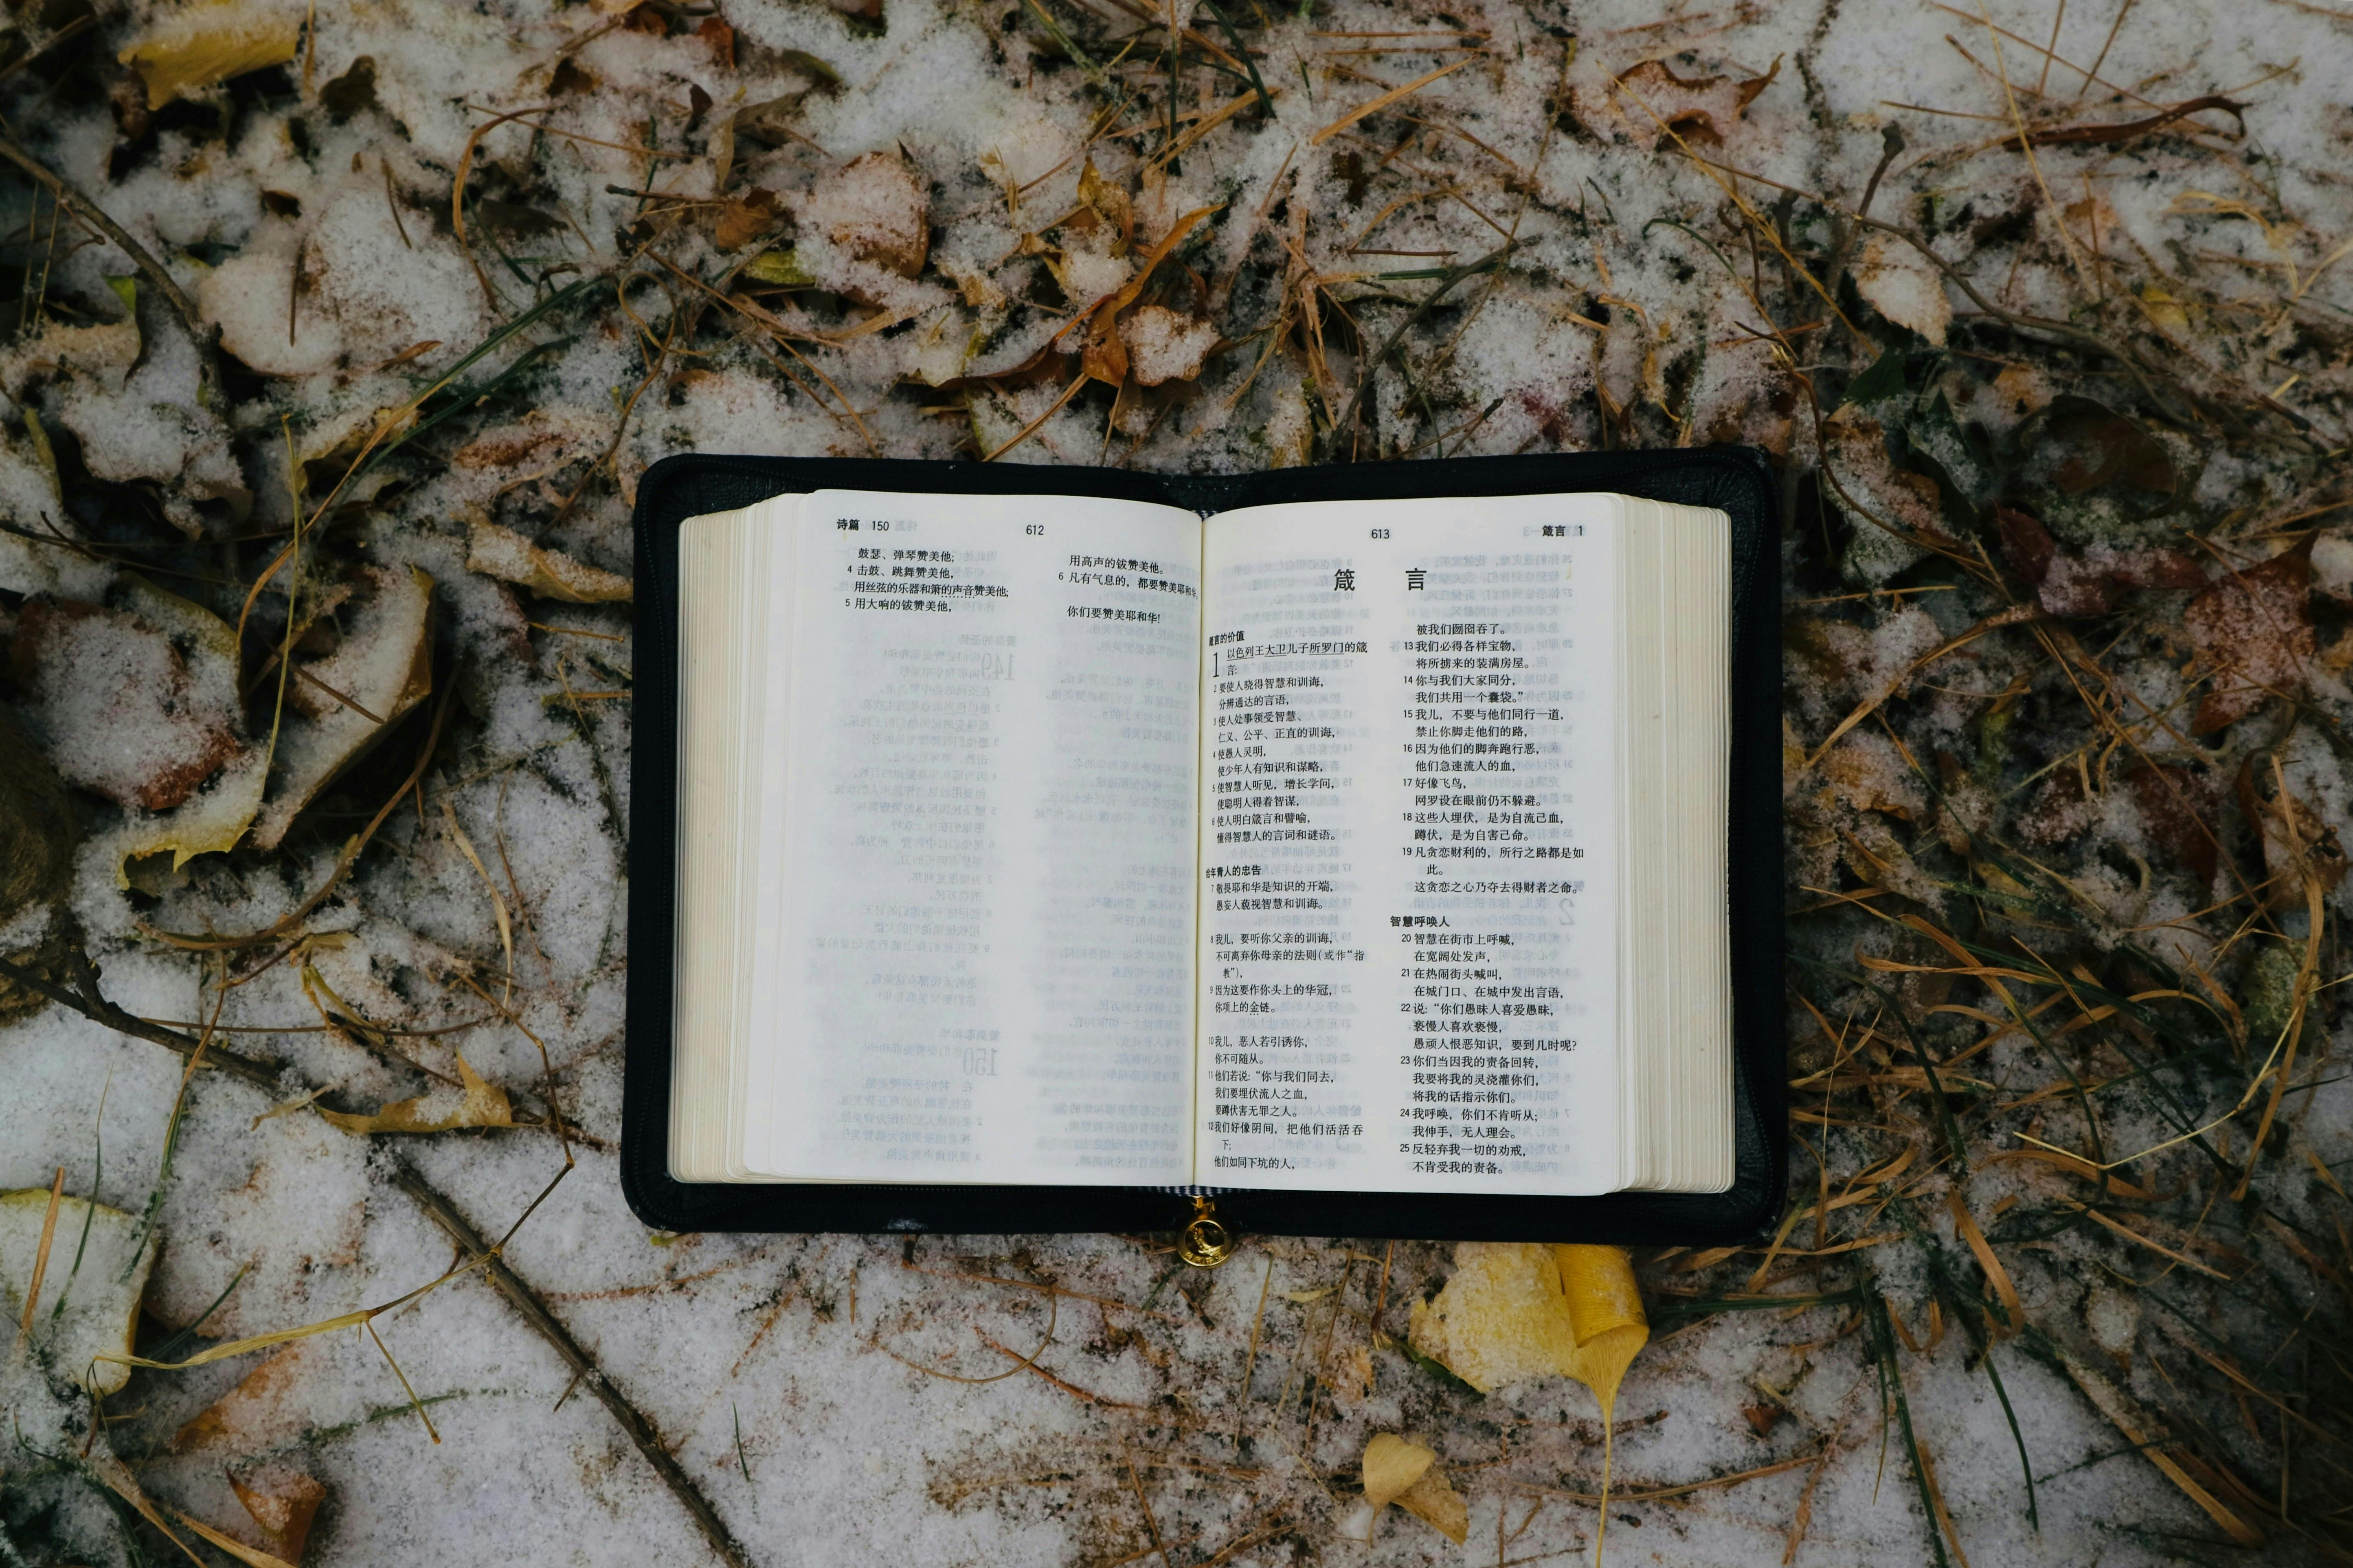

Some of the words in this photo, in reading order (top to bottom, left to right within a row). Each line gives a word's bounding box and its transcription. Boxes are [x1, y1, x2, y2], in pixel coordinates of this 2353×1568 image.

[836, 518, 860, 531] 诗篇
[872, 520, 889, 531] 150
[1026, 525, 1044, 536] 612
[1371, 529, 1389, 539] 613
[1542, 525, 1566, 537] 箴言
[1578, 525, 1583, 536] 1
[847, 565, 852, 573] 4
[1058, 572, 1064, 580] 6
[1333, 569, 1355, 591] 箴
[1405, 567, 1427, 591] 言
[845, 598, 850, 607] 5
[1067, 605, 1160, 624] 你们要赞美耶和华！
[1209, 630, 1245, 647] 箴言的价值
[1404, 641, 1414, 650] 13
[1213, 652, 1220, 678] 1
[1227, 641, 1368, 661] 以色列王大卫儿子所罗门的箴
[1404, 676, 1413, 684] 14
[1214, 685, 1217, 693] 2
[1415, 691, 1523, 704] 我们共用一个囊袋。”
[1404, 709, 1413, 718] 15
[1214, 718, 1216, 726] 3
[1218, 710, 1302, 727] 使人处事领受智慧、
[1403, 744, 1413, 753] 16
[1403, 778, 1412, 786] 17
[1212, 784, 1215, 792] 5
[1212, 817, 1215, 826] 6
[1403, 813, 1412, 821] 18
[1403, 847, 1412, 856] 19
[1415, 846, 1584, 859] 凡贪恋财利的，所行之路都是如
[1390, 915, 1450, 927] 智慧呼唤人
[1210, 935, 1214, 944] 8
[1401, 933, 1411, 942] 20
[1401, 968, 1409, 977] 21
[1210, 986, 1213, 994] 9
[1401, 1003, 1411, 1012] 22
[1209, 1037, 1214, 1045] 10
[1414, 1038, 1577, 1052] 愚顽人恨恶知识，要到几时呢？
[1400, 1056, 1410, 1065] 23
[1208, 1071, 1213, 1079] 11
[1400, 1108, 1410, 1117] 24
[1208, 1122, 1214, 1130] 12
[1214, 1121, 1363, 1136] 我们好像阴间，把他们活活吞
[1400, 1143, 1410, 1152] 25
